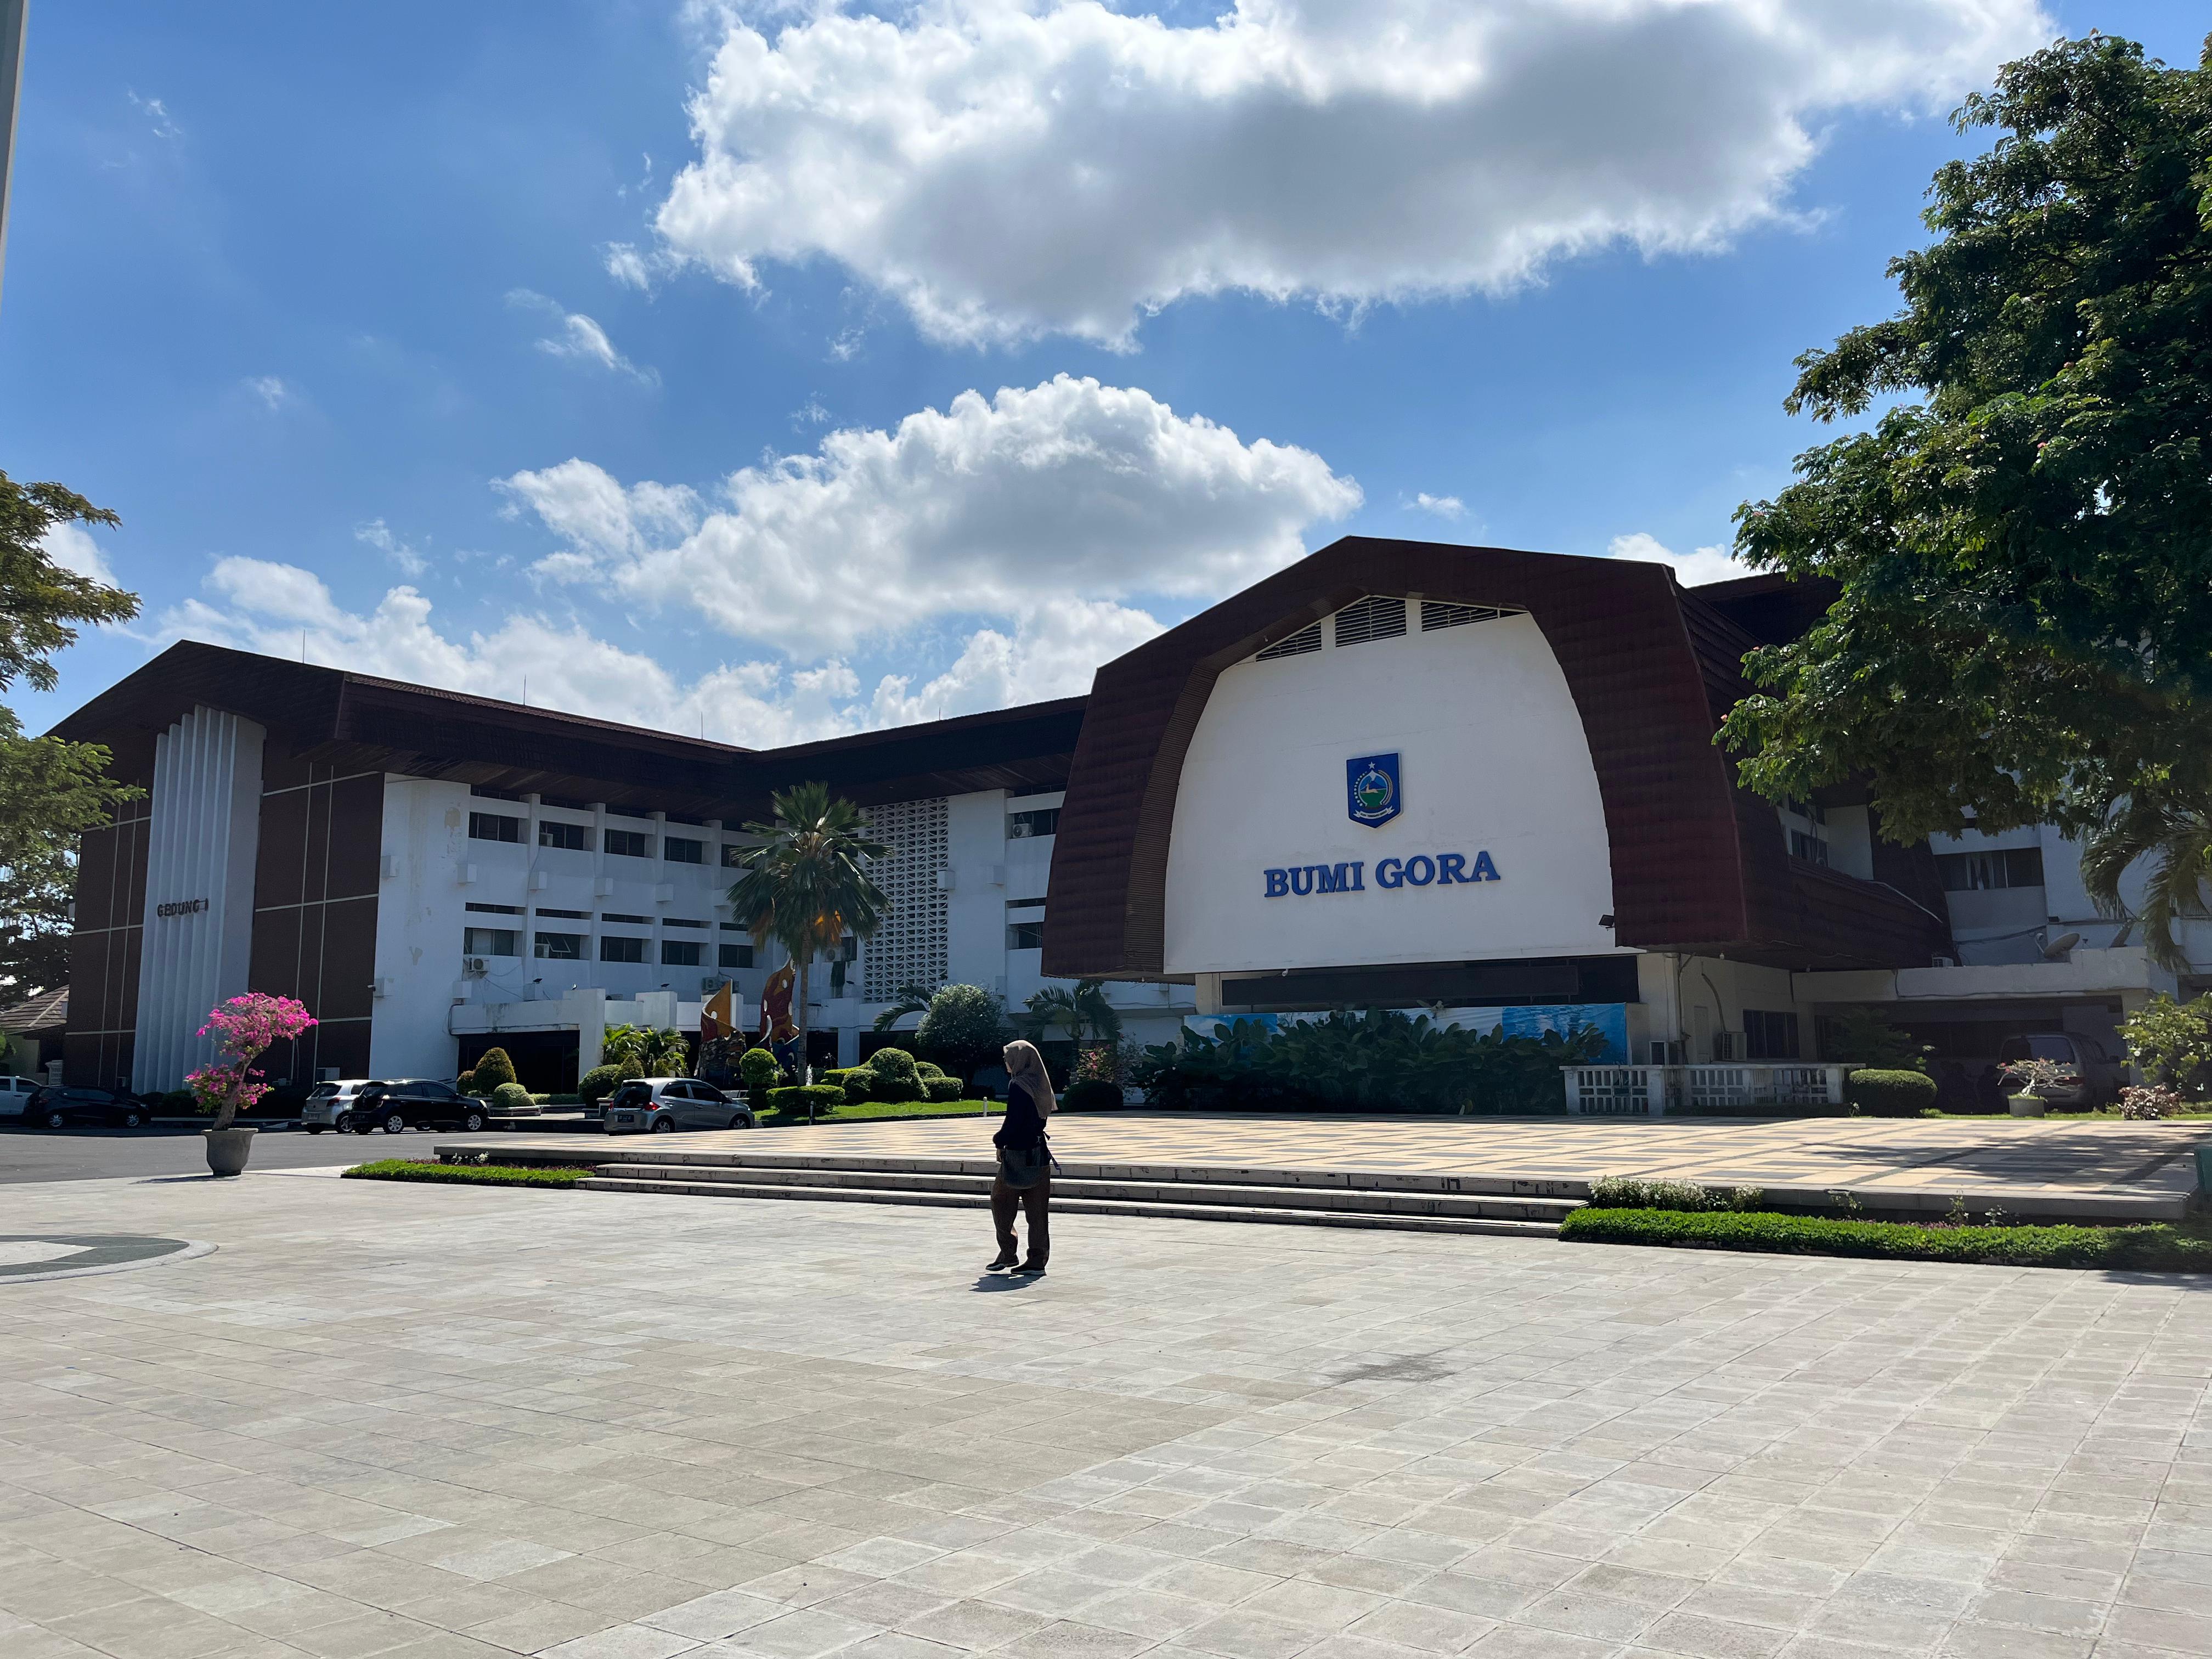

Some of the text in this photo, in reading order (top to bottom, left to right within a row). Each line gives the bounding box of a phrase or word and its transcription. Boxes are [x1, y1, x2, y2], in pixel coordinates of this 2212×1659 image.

[1263, 850, 1501, 898] BUMI GORA
[157, 899, 200, 917] GEDUNG
